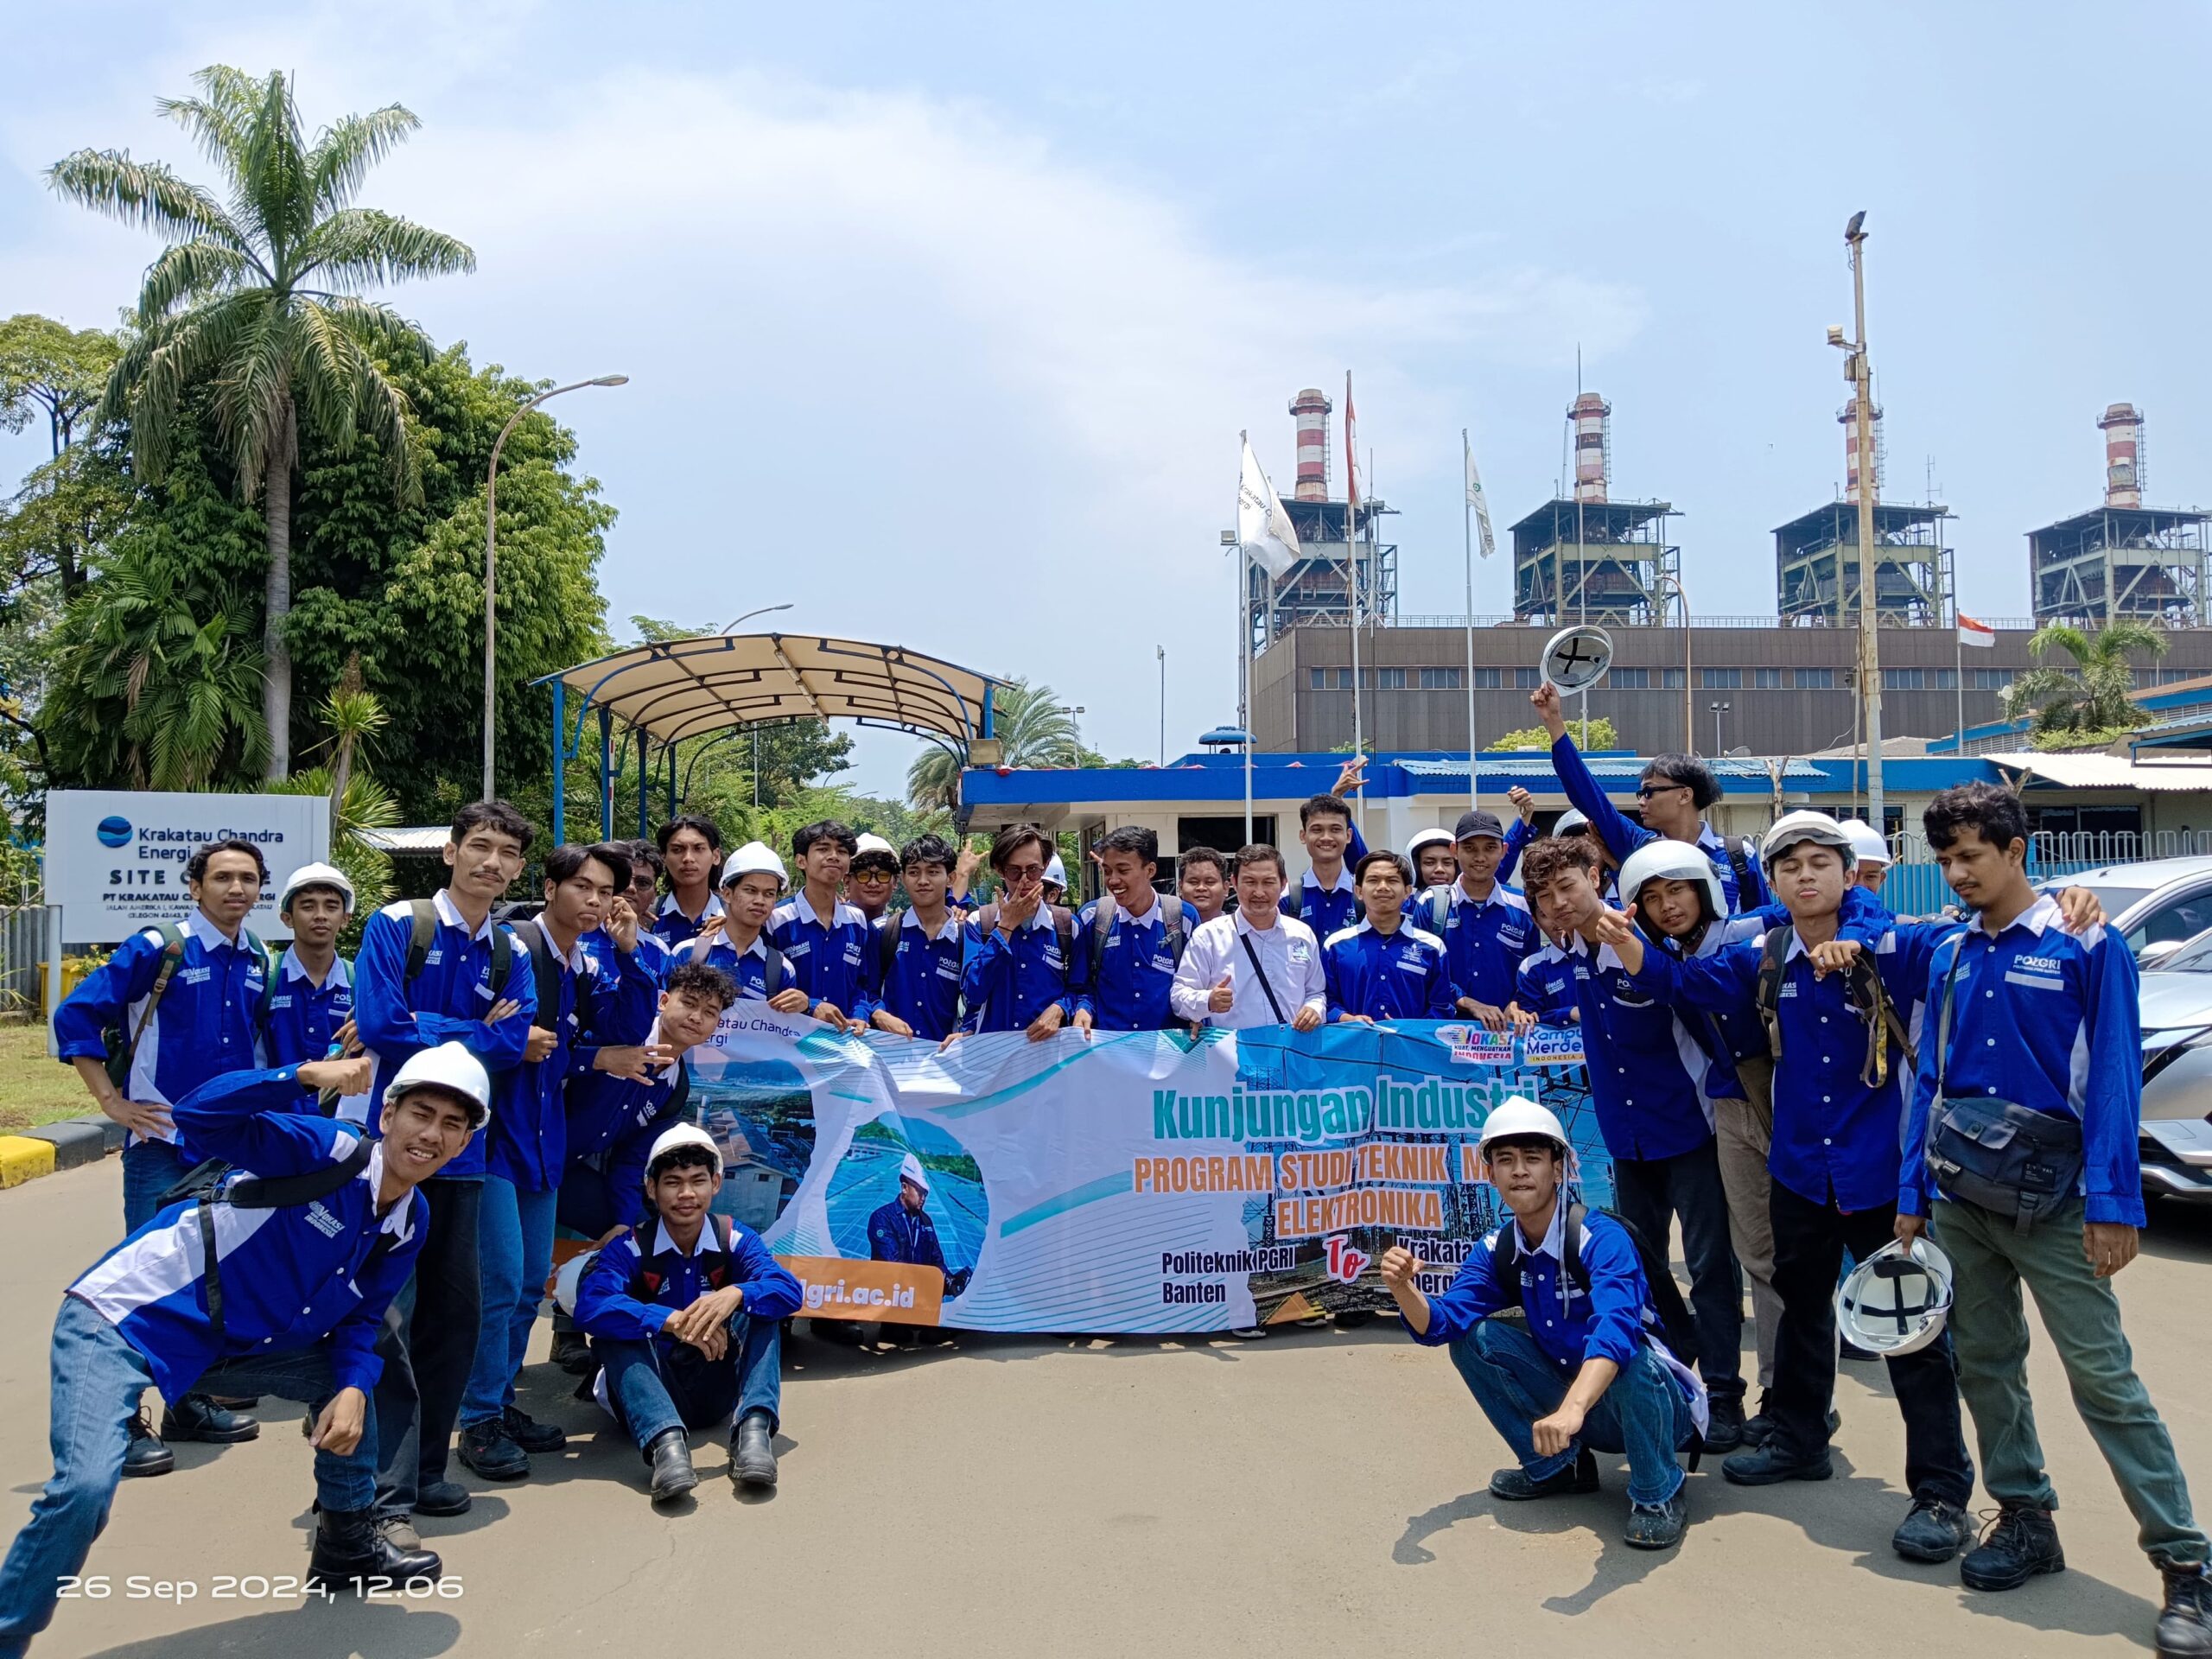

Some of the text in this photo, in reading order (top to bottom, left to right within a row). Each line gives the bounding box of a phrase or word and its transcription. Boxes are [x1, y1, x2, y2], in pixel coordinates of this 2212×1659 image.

[138, 827, 284, 843] Krakatau Chandra
[138, 845, 191, 862] Energi
[109, 869, 166, 885] SITE
[102, 893, 117, 902] PT
[118, 893, 180, 902] KRAKATAU
[259, 893, 276, 901] RGI
[2013, 954, 2062, 970] POLGRI
[717, 1018, 747, 1030] atau
[1526, 1039, 1582, 1055] Merde
[1532, 1053, 1577, 1062] INDONESIA
[1153, 1078, 1535, 1142] Kunjungan Indust
[1134, 1155, 1273, 1193] PROGRAM
[1281, 1150, 1353, 1190] STUDI
[1357, 1144, 1448, 1181] TEKNIK
[1277, 1189, 1442, 1236] ELEKTRONIKA
[1399, 1236, 1472, 1263] Krakata
[1162, 1247, 1294, 1274] Politeknik PGRI
[1325, 1238, 1367, 1280] To
[1162, 1282, 1226, 1304] Banten
